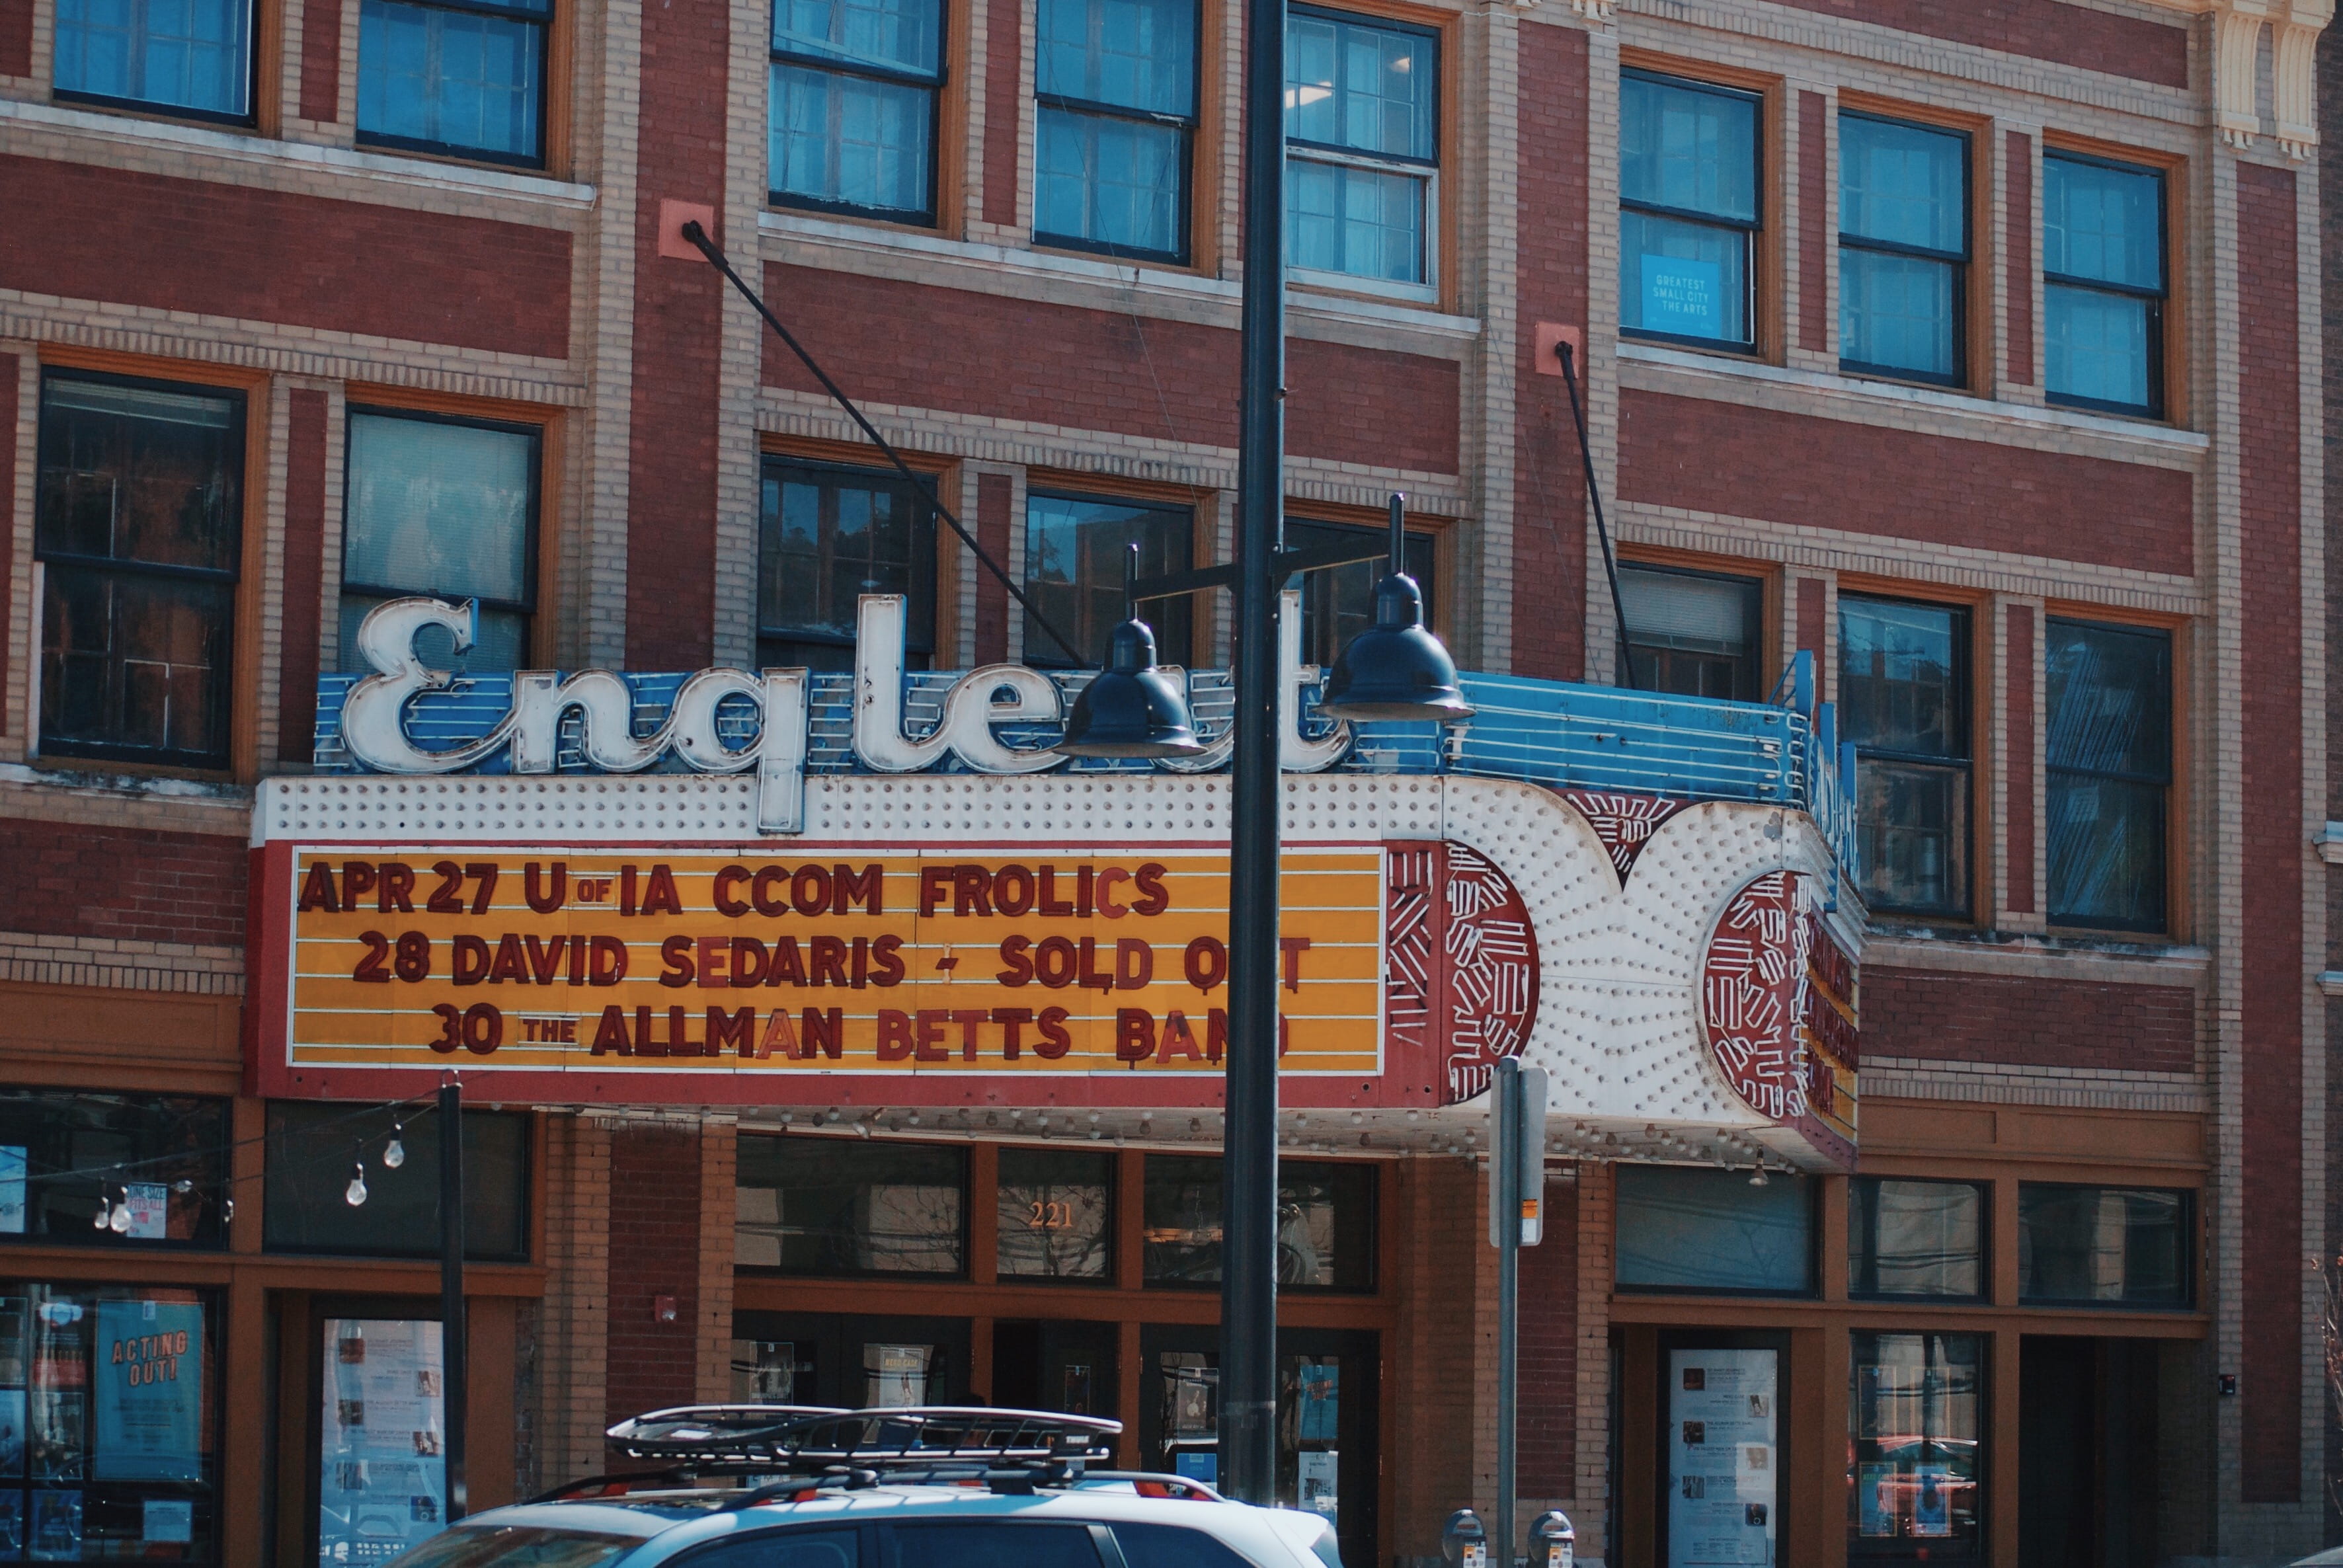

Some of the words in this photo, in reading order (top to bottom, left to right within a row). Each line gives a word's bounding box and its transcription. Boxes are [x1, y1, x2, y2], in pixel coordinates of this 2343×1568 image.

[1652, 287, 1685, 301] SMALL
[1687, 292, 1709, 303] CITY
[1655, 274, 1706, 290] GREATEST
[1662, 300, 1681, 313] THE
[1683, 304, 1708, 316] ARTS
[299, 861, 415, 915] APR
[427, 861, 498, 916] 27
[524, 861, 567, 915] U
[576, 879, 612, 903] OF
[620, 865, 683, 918] IA
[713, 864, 883, 918] CCOM
[919, 863, 1170, 920] FROLICS
[353, 930, 431, 984] 28
[452, 933, 629, 987] DAVID
[660, 935, 906, 990] SEDARIS
[996, 934, 1154, 993] SOLD
[1183, 936, 1310, 994] OT
[429, 1002, 503, 1056] 30
[522, 1019, 577, 1042] THE
[590, 1004, 844, 1062] ALLMAN
[877, 1007, 1072, 1062] BETTS
[1115, 1007, 1289, 1068] BAN
[1029, 1201, 1072, 1228] 221
[112, 1330, 188, 1364] ACTING
[129, 1356, 178, 1386] OUT!
